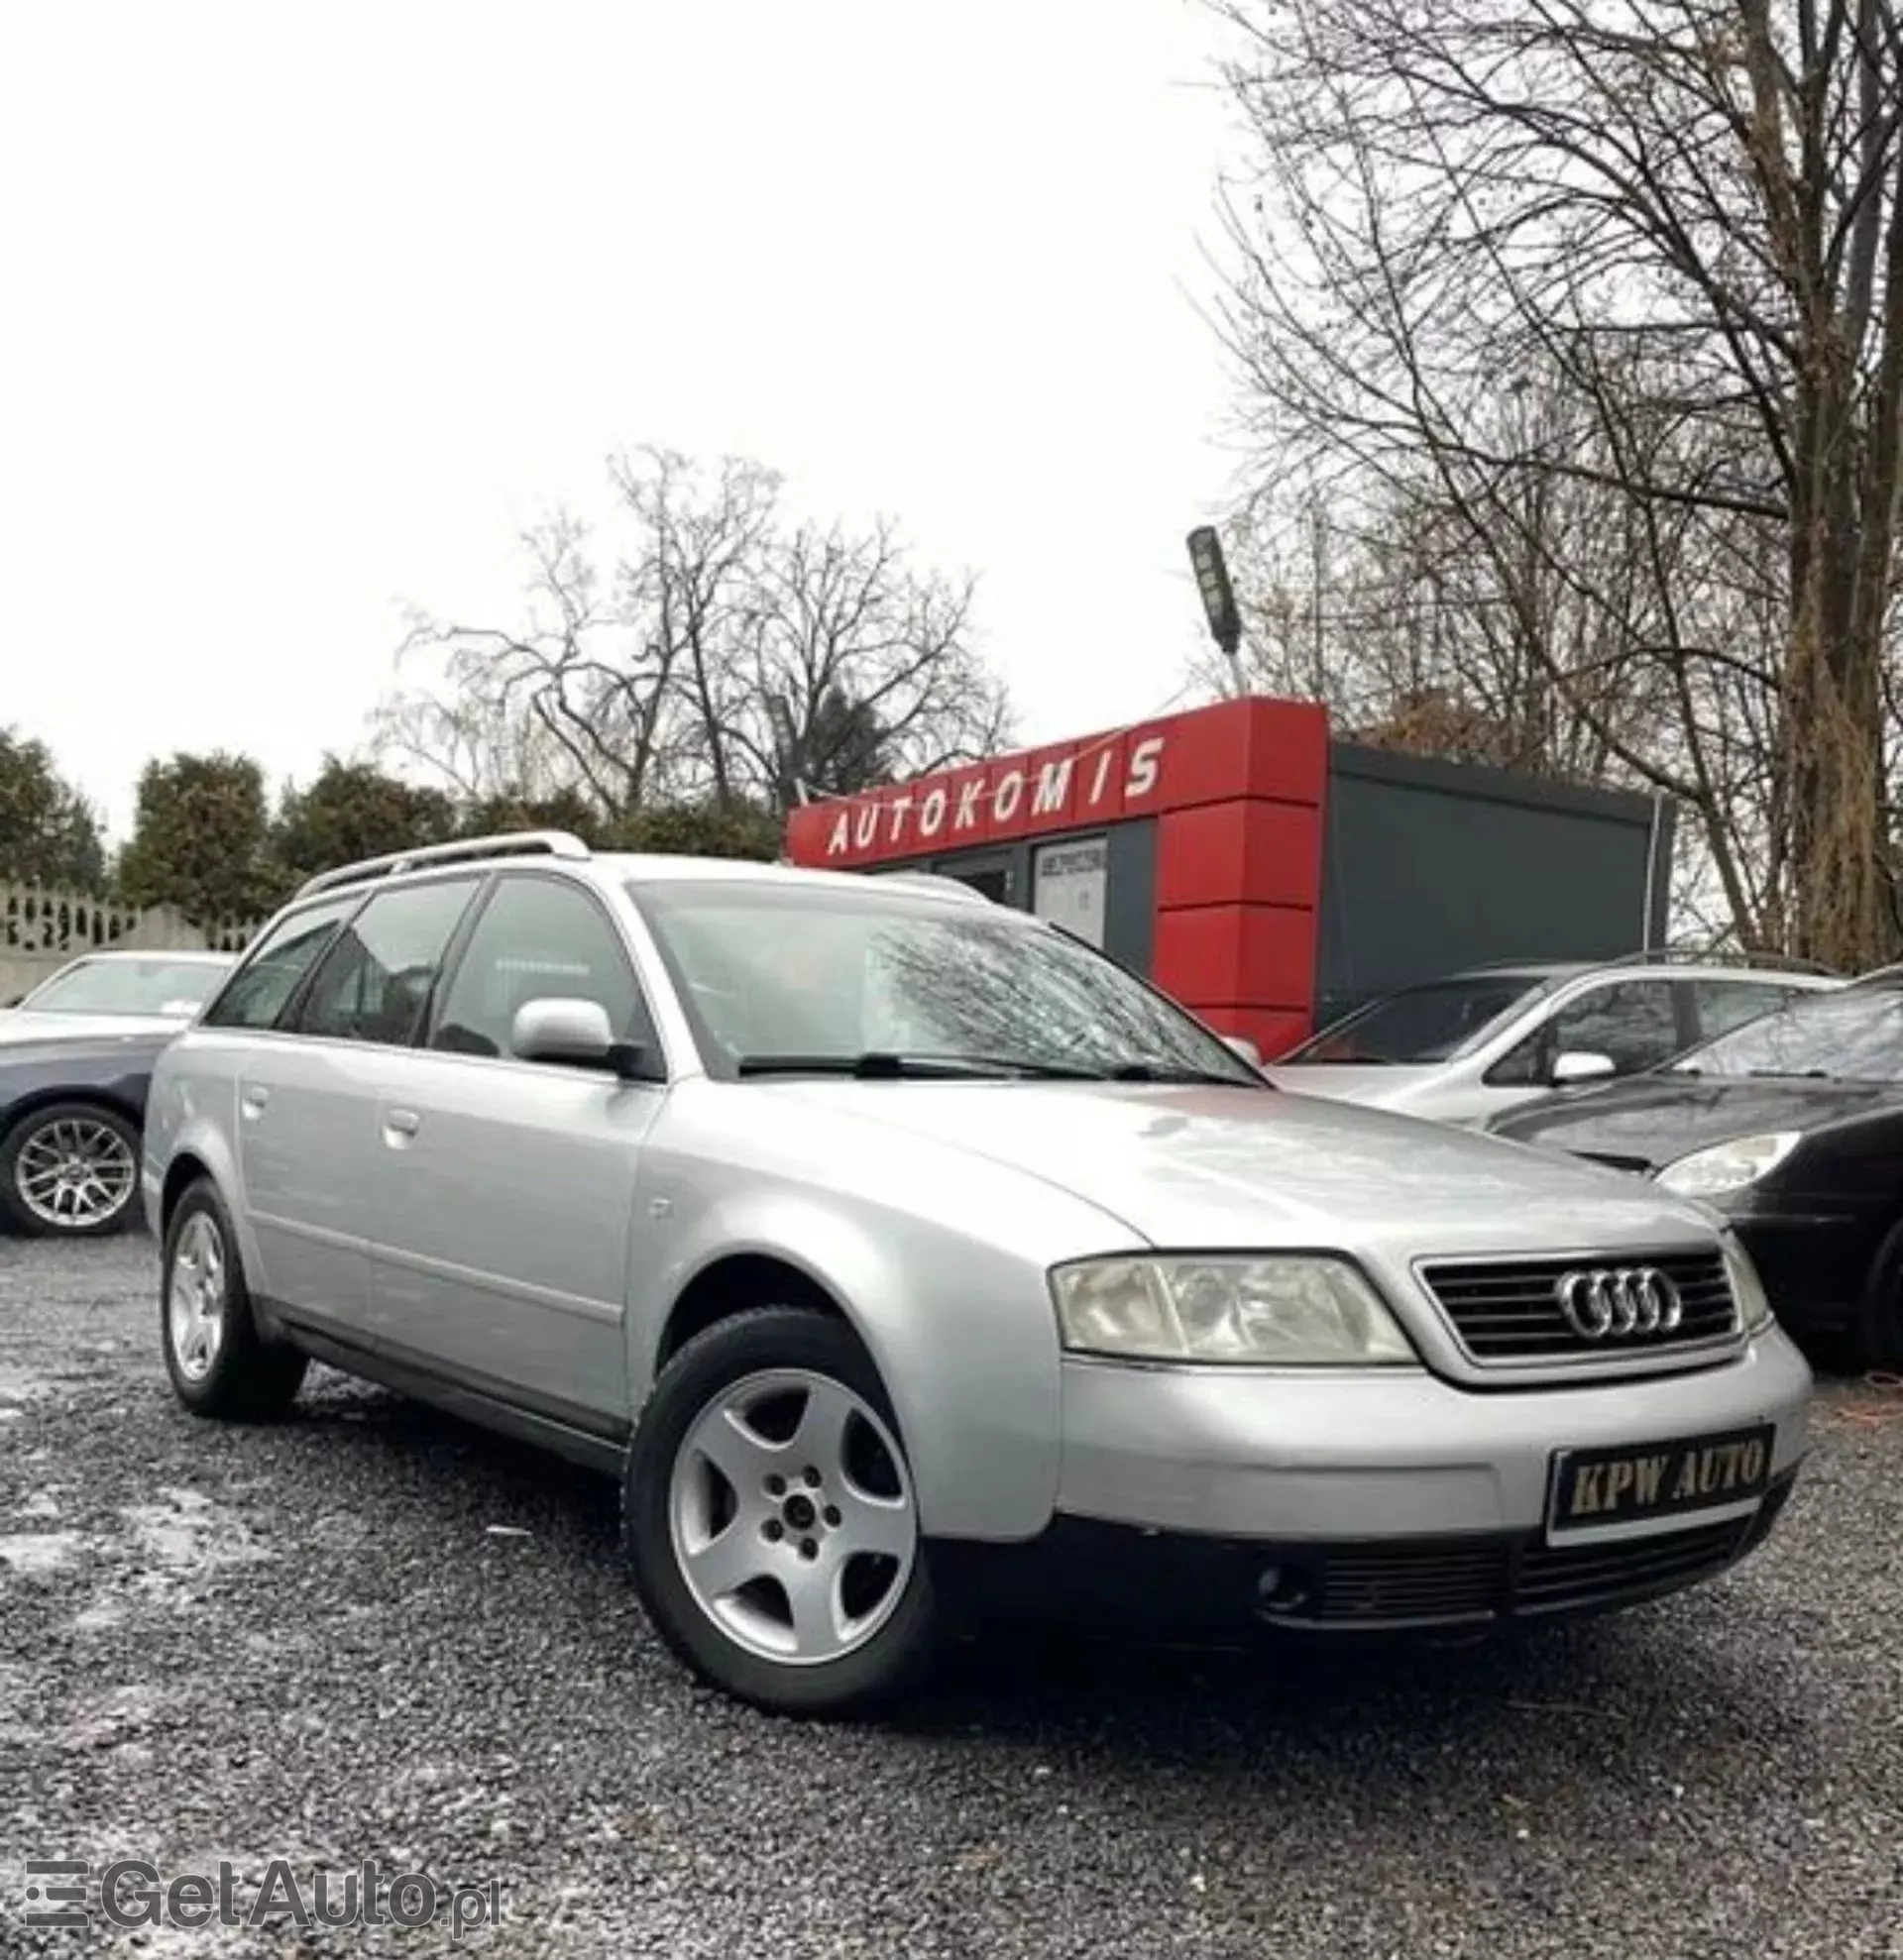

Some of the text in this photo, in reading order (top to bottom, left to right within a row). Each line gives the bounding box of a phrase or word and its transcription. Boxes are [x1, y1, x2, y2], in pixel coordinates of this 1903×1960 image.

[828, 737, 1165, 855] AUTOKOMIS
[1571, 1439, 1765, 1515] KPW AUTO
